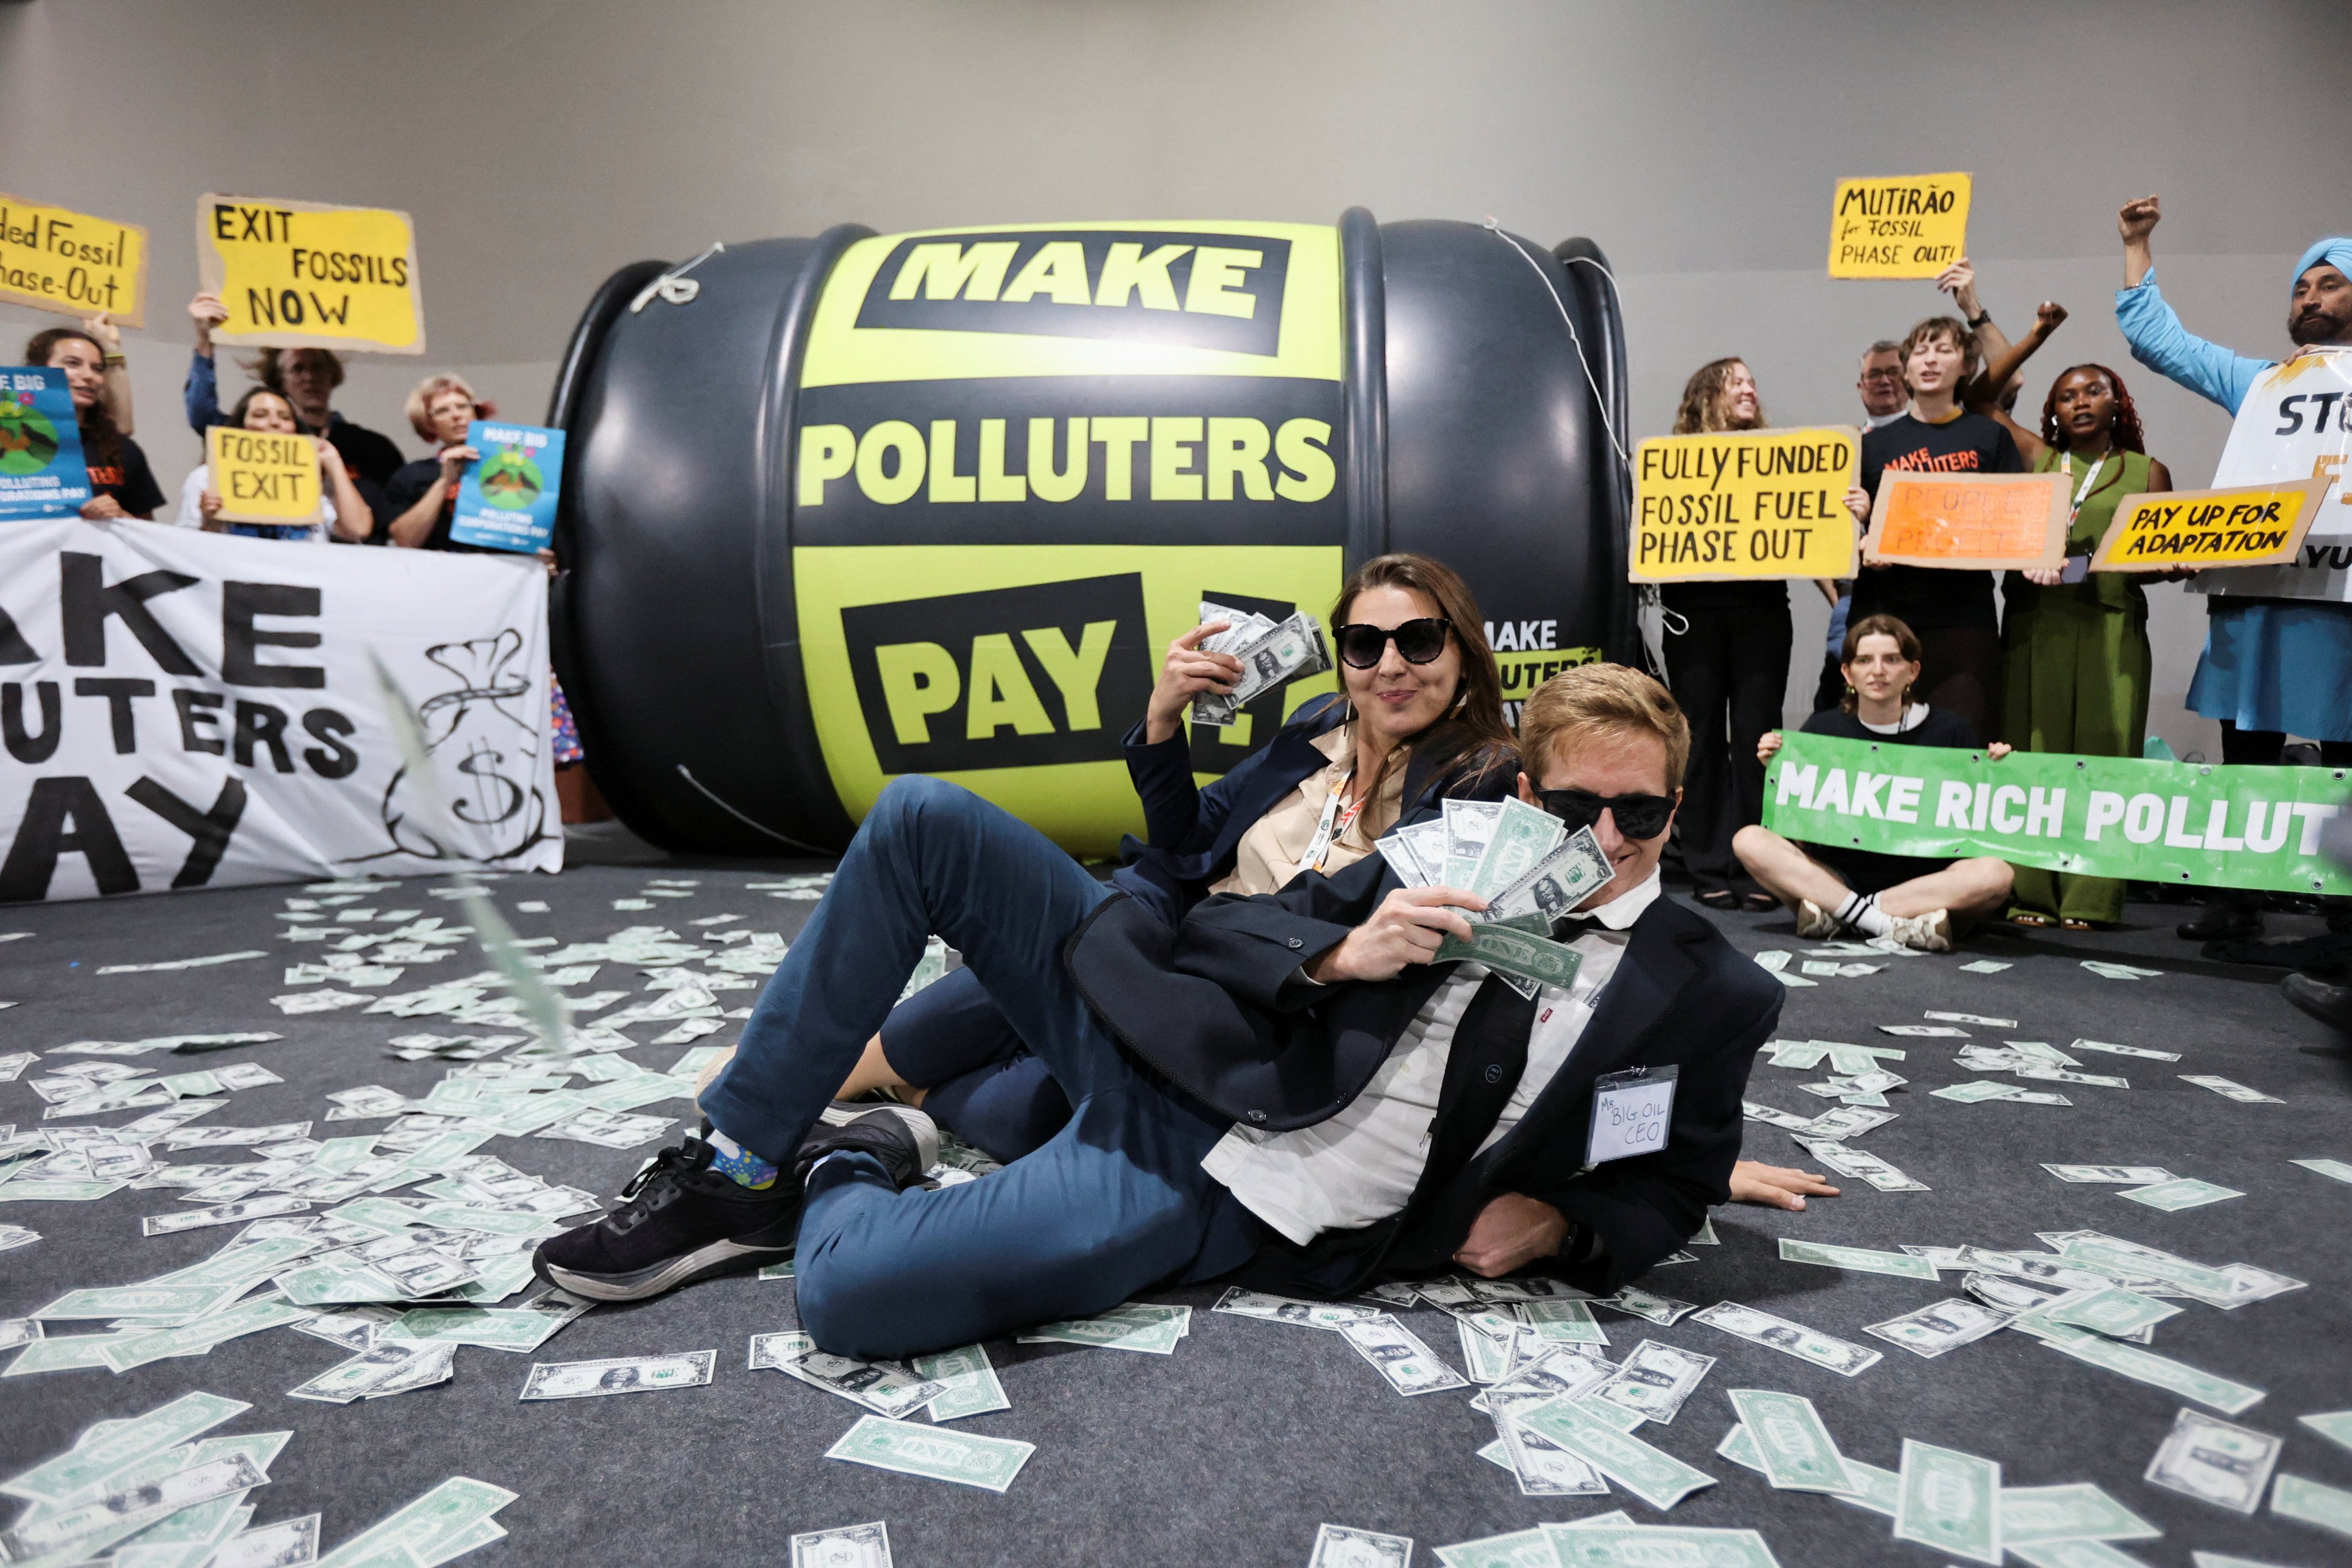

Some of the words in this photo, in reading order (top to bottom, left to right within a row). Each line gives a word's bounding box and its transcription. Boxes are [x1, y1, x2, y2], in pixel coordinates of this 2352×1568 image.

[214, 204, 293, 242] EXIT
[1868, 219, 1924, 237] FOSSIL
[48, 219, 125, 268] Fossil
[1841, 245, 1903, 265] PHASE
[1914, 246, 1955, 265] OUT!
[293, 248, 408, 287] FOSSILS
[889, 241, 1264, 319] MAKE
[248, 288, 349, 326] NOW
[13, 375, 45, 391] BIG
[219, 434, 309, 467] FOSSIL
[798, 416, 1336, 507] POLLUTERS
[1643, 447, 1731, 490] FULLY
[1739, 443, 1849, 478] FUNDED
[233, 471, 304, 501] EXIT
[1642, 494, 1739, 527] FOSSIL
[1755, 490, 1837, 522] FUEL
[2132, 505, 2183, 531] PAY
[2188, 504, 2224, 527] UP
[2226, 501, 2281, 526] FOR
[1640, 531, 1737, 565] PHASE
[1751, 529, 1812, 562] OUT
[2126, 530, 2288, 555] ADAPTATION
[875, 619, 1117, 746] PAY
[1775, 760, 1924, 824] MAKE
[1935, 779, 2067, 839] RICH
[1481, 937, 1531, 959] ONE
[1611, 1106, 1637, 1126] BIG
[1642, 1103, 1665, 1118] OIL
[1624, 1122, 1659, 1144] CEO
[903, 1441, 962, 1463] ONE
